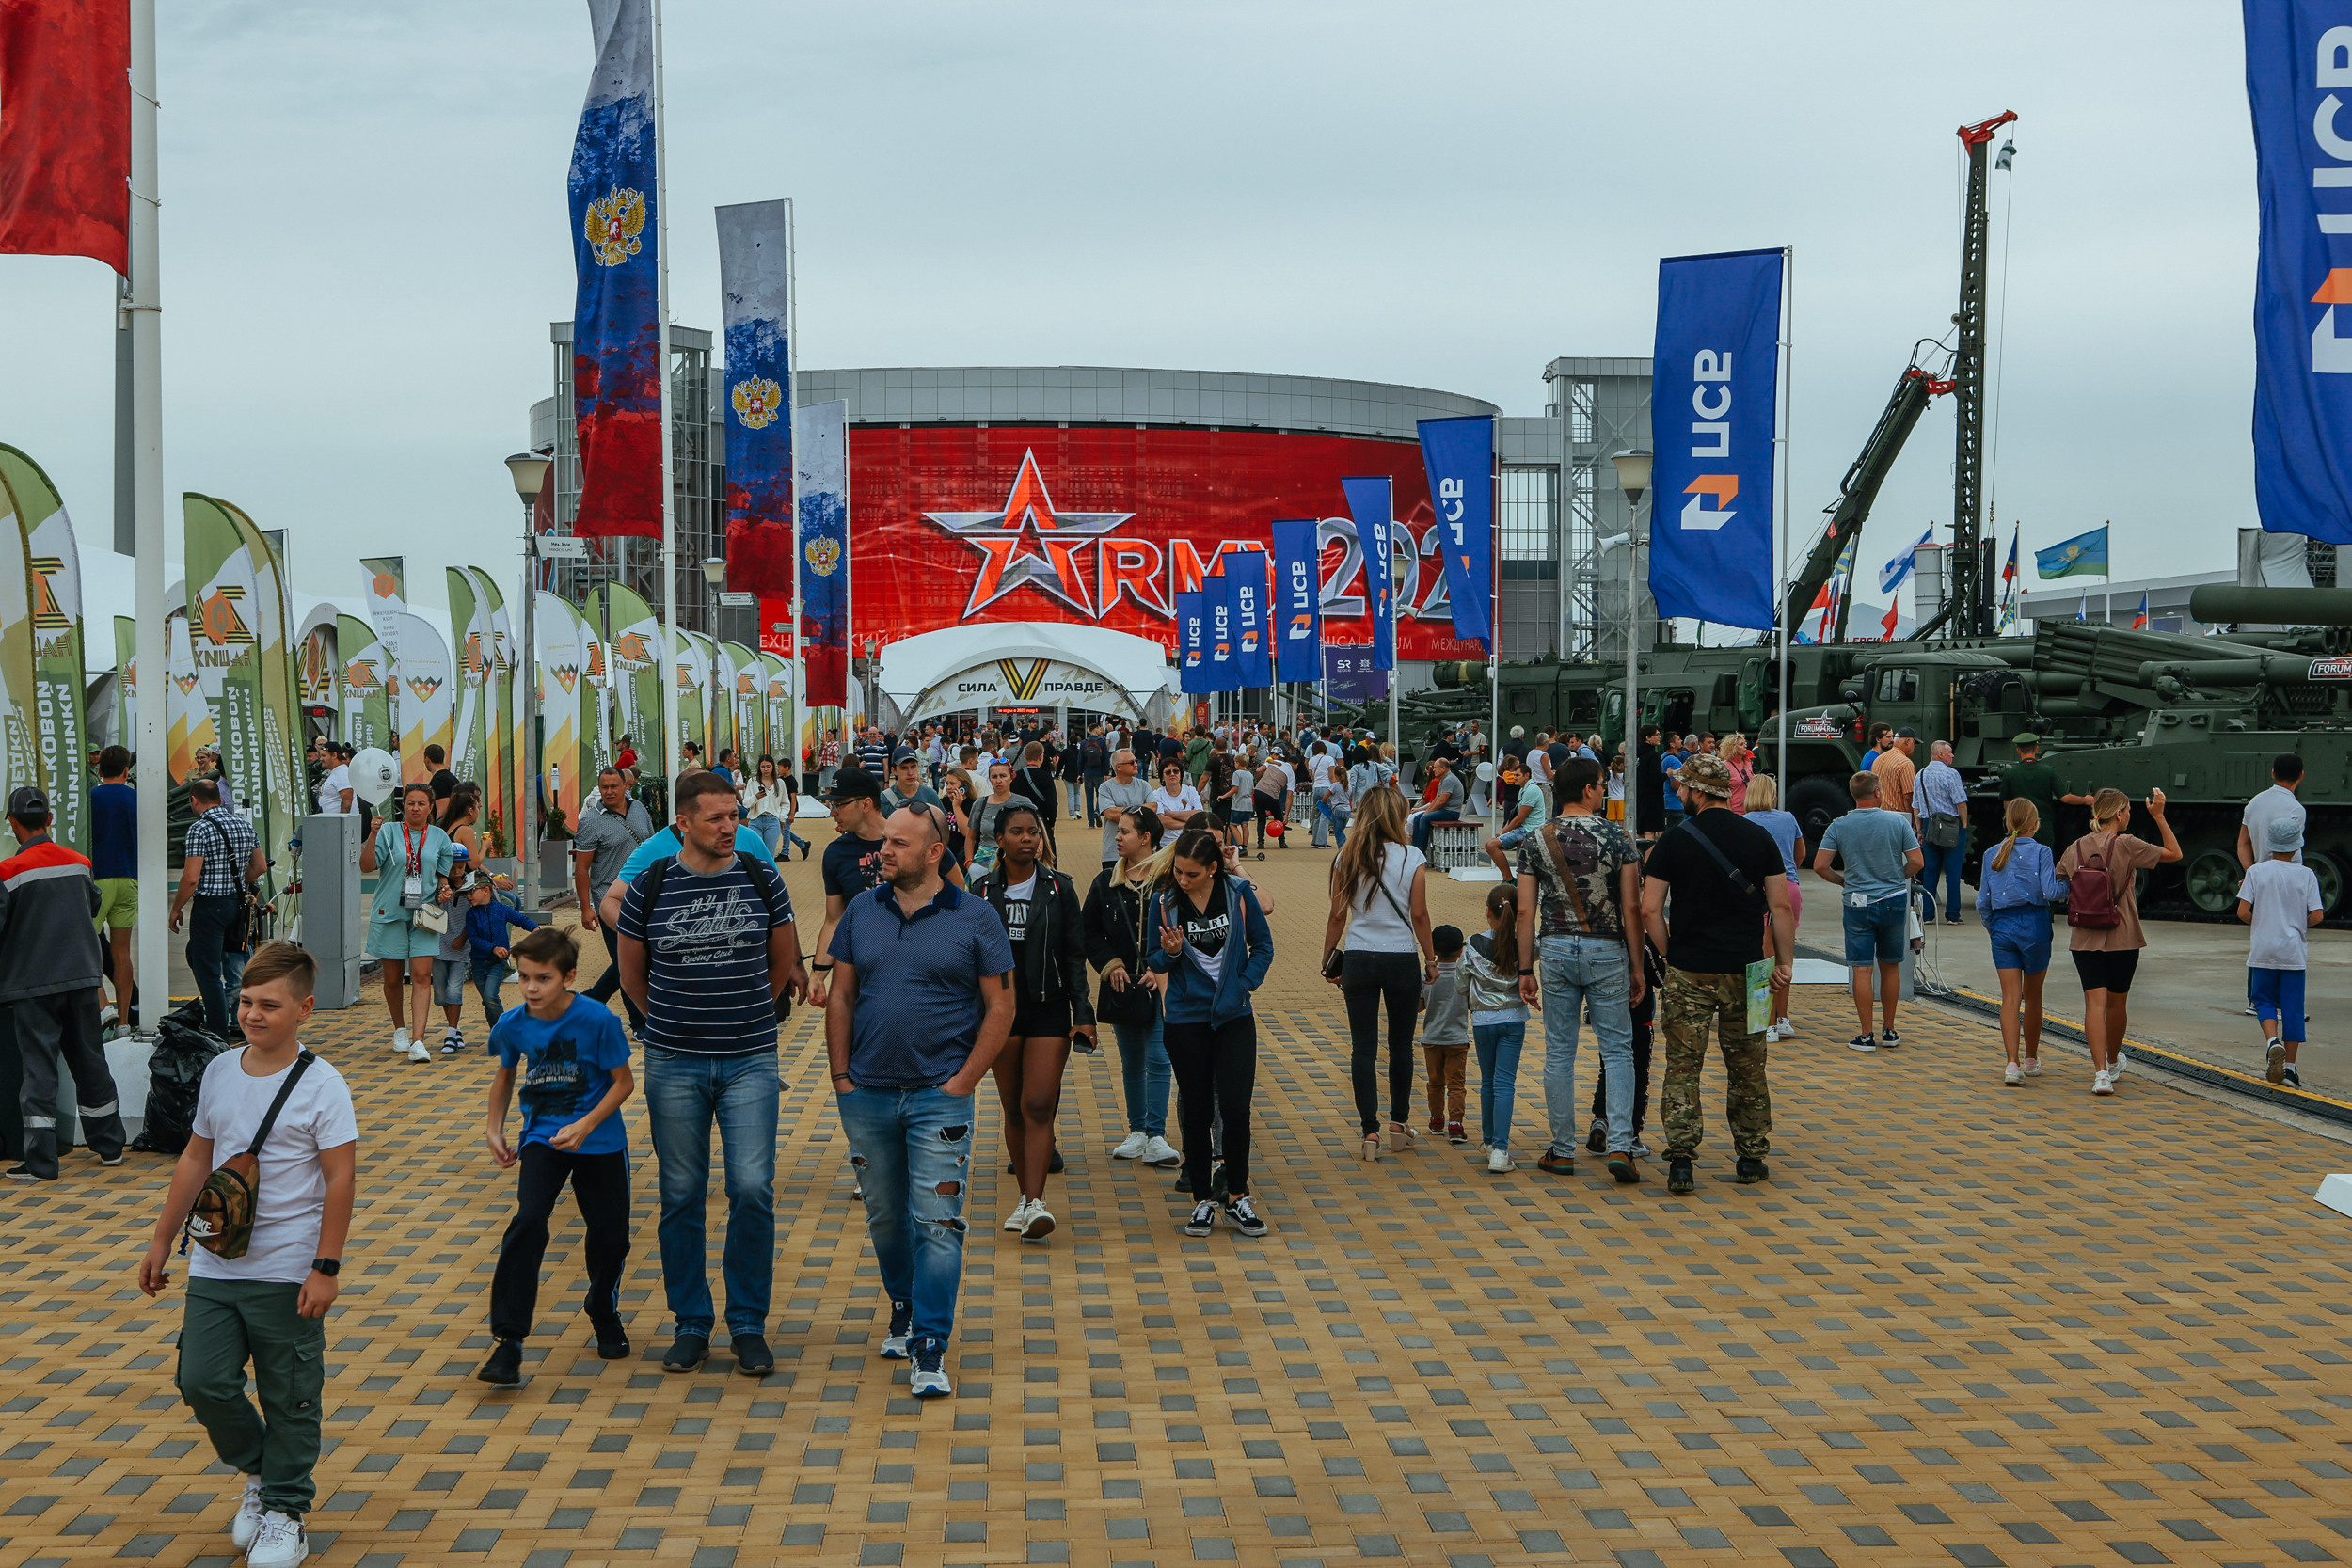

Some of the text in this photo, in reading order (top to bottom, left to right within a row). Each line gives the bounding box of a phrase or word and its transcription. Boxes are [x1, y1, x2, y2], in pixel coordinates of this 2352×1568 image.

[1431, 637, 1486, 653] МЕЖДУНАРО
[958, 683, 997, 692] СИЛА
[1044, 682, 1104, 693] ПРАВДЕ
[1190, 915, 1225, 931] SRT
[681, 953, 712, 964] Racing
[713, 949, 734, 958] Club
[191, 1214, 212, 1234] NIKE
